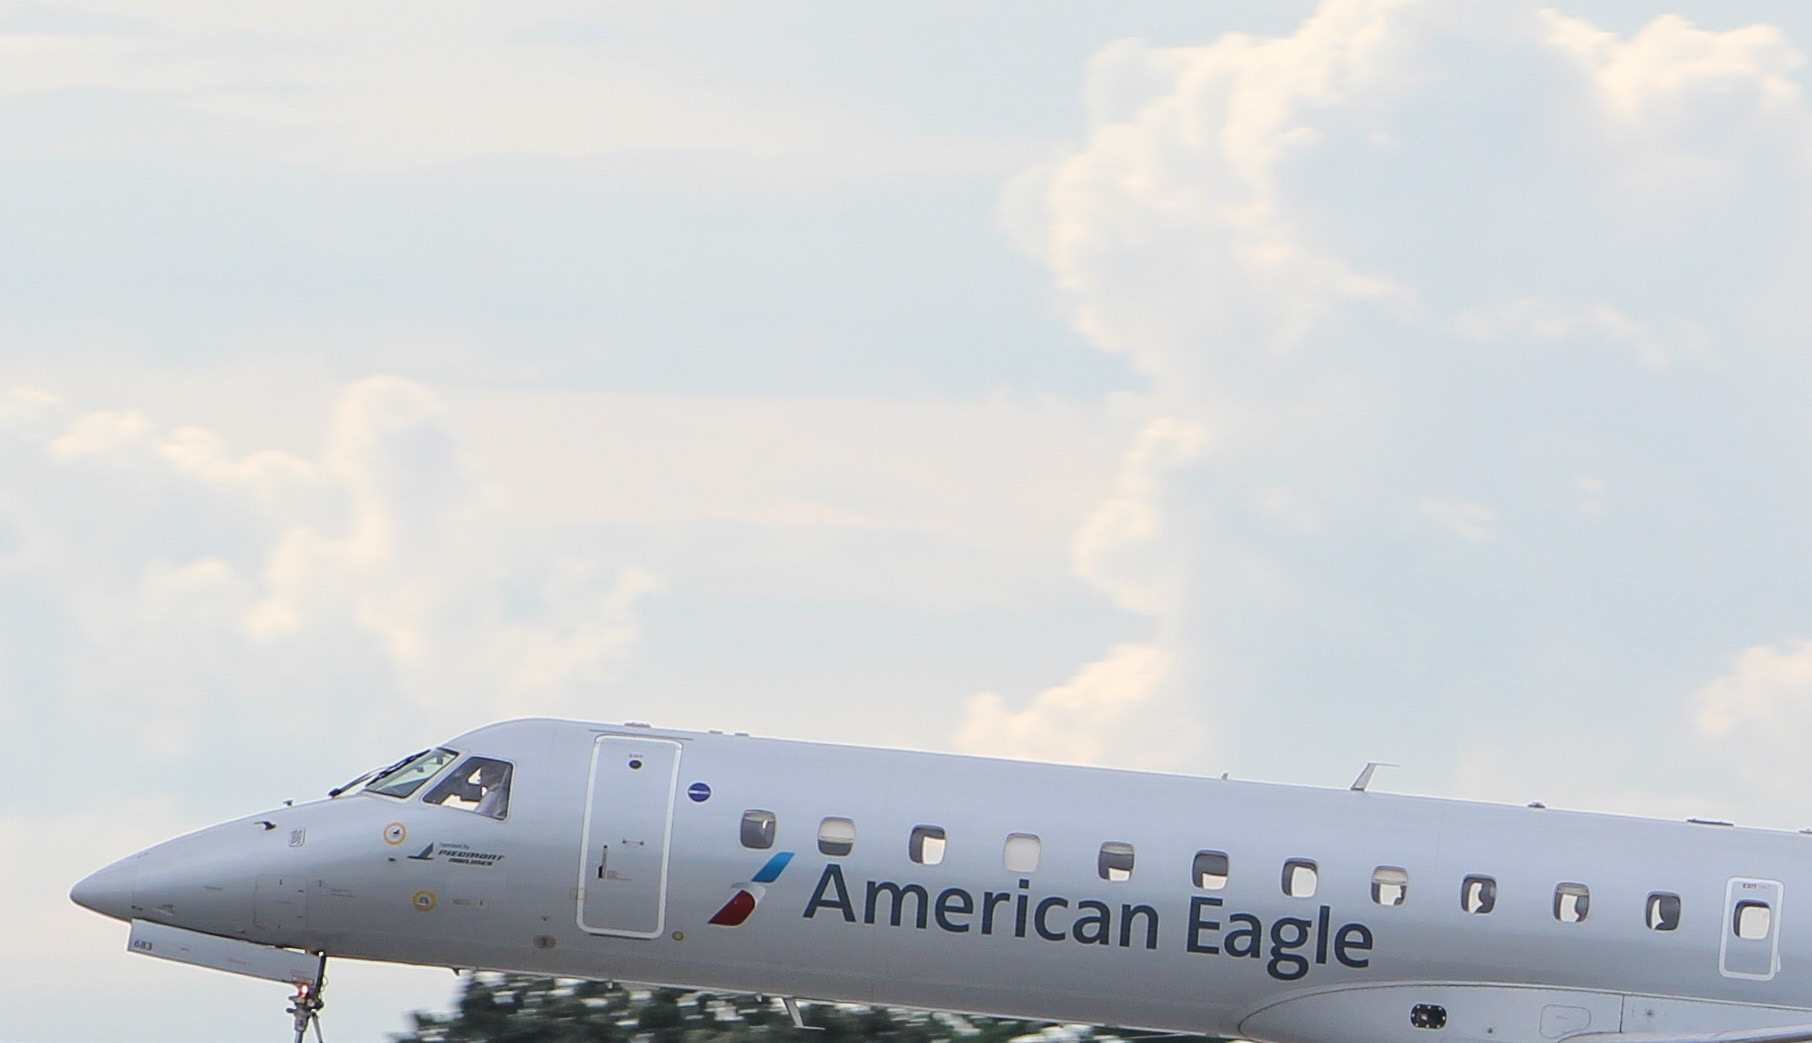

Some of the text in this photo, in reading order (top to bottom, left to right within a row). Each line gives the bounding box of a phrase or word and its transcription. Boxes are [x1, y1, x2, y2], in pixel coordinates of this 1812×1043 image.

[134, 940, 153, 951] 683
[802, 863, 1373, 981] American Eagle
